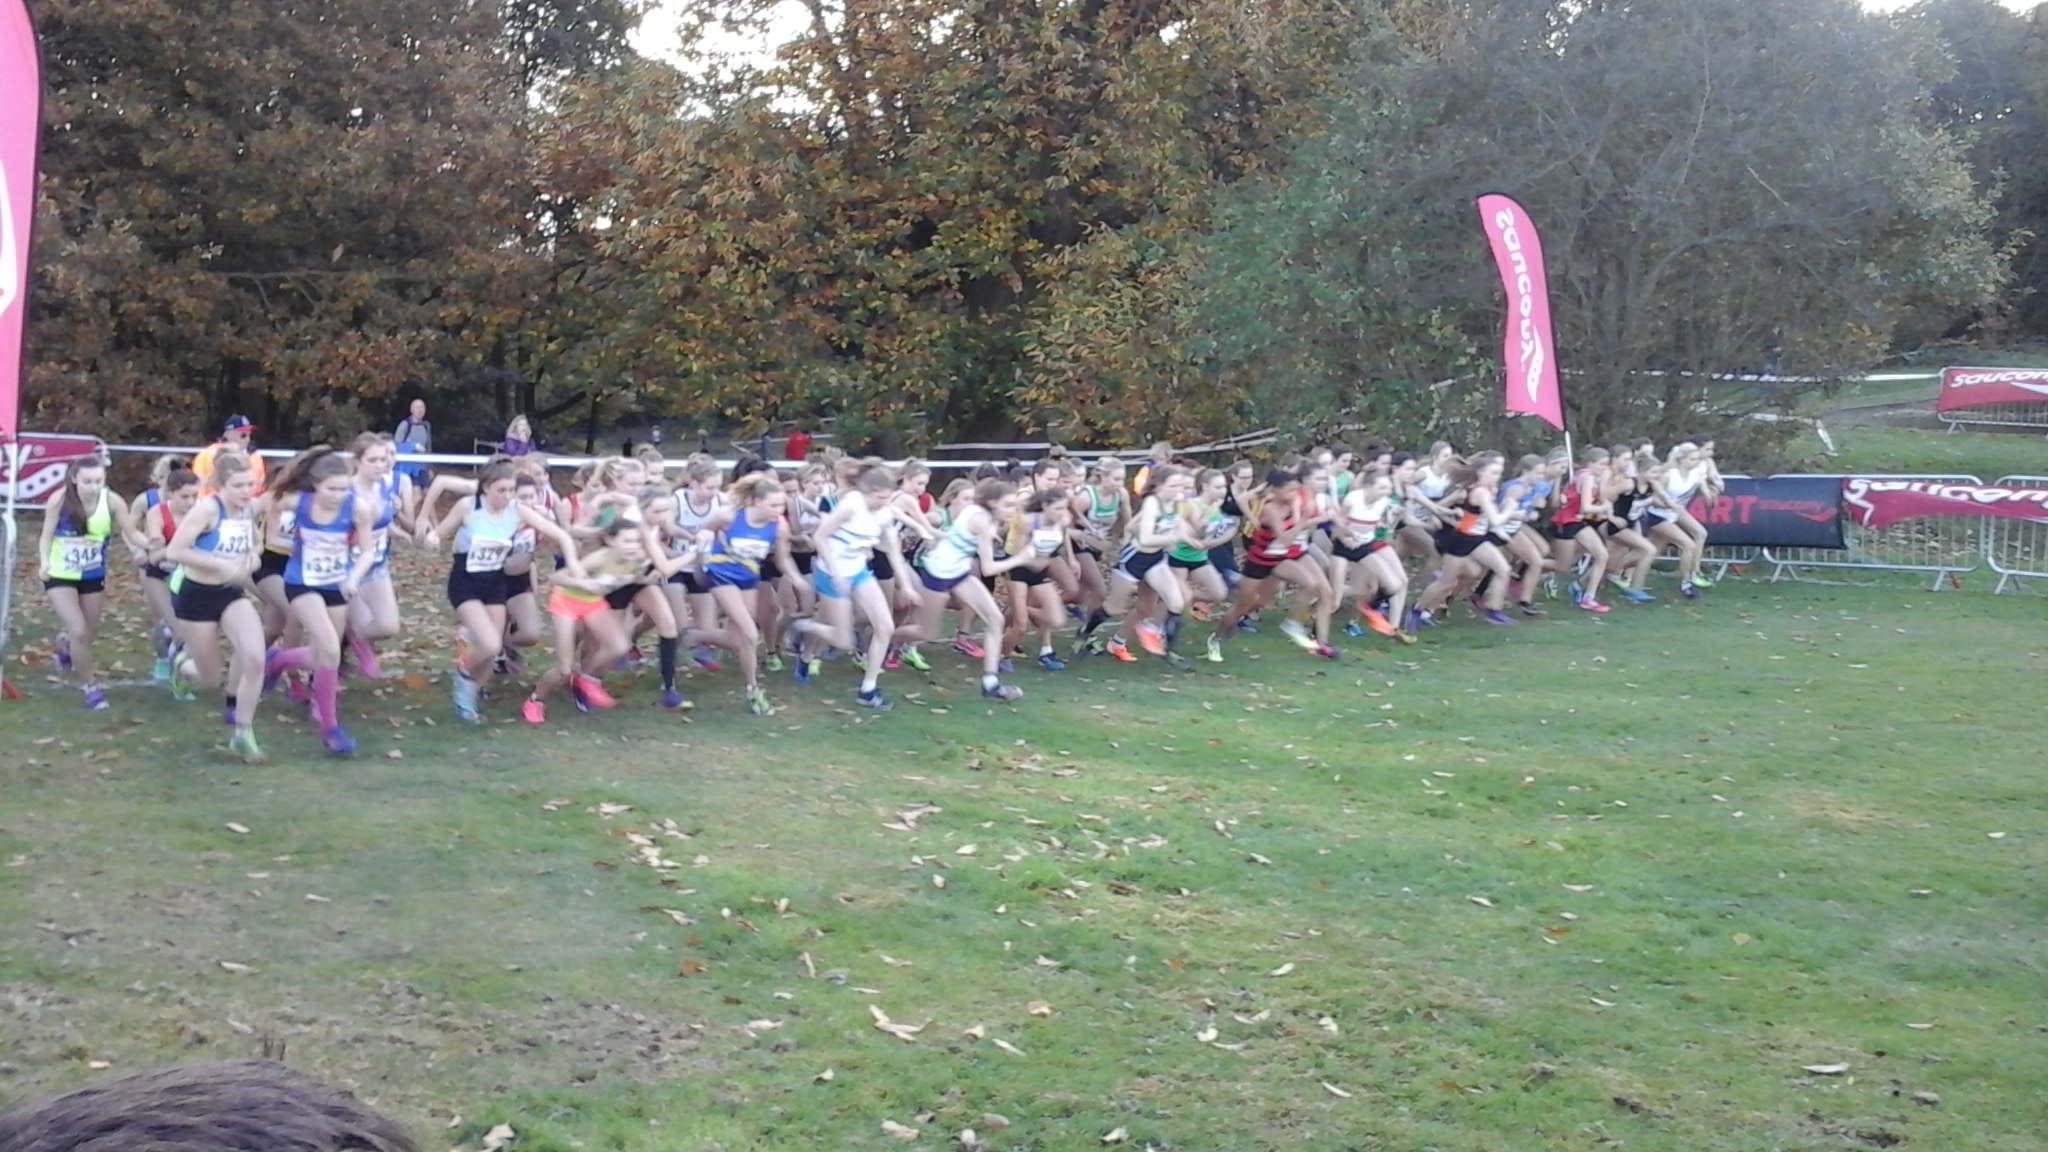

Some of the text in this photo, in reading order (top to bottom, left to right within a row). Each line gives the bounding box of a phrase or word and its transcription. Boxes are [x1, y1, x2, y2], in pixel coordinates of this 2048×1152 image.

[1950, 371, 2048, 388] saucon
[1842, 479, 2048, 509] saucon
[1688, 495, 1758, 524] ART
